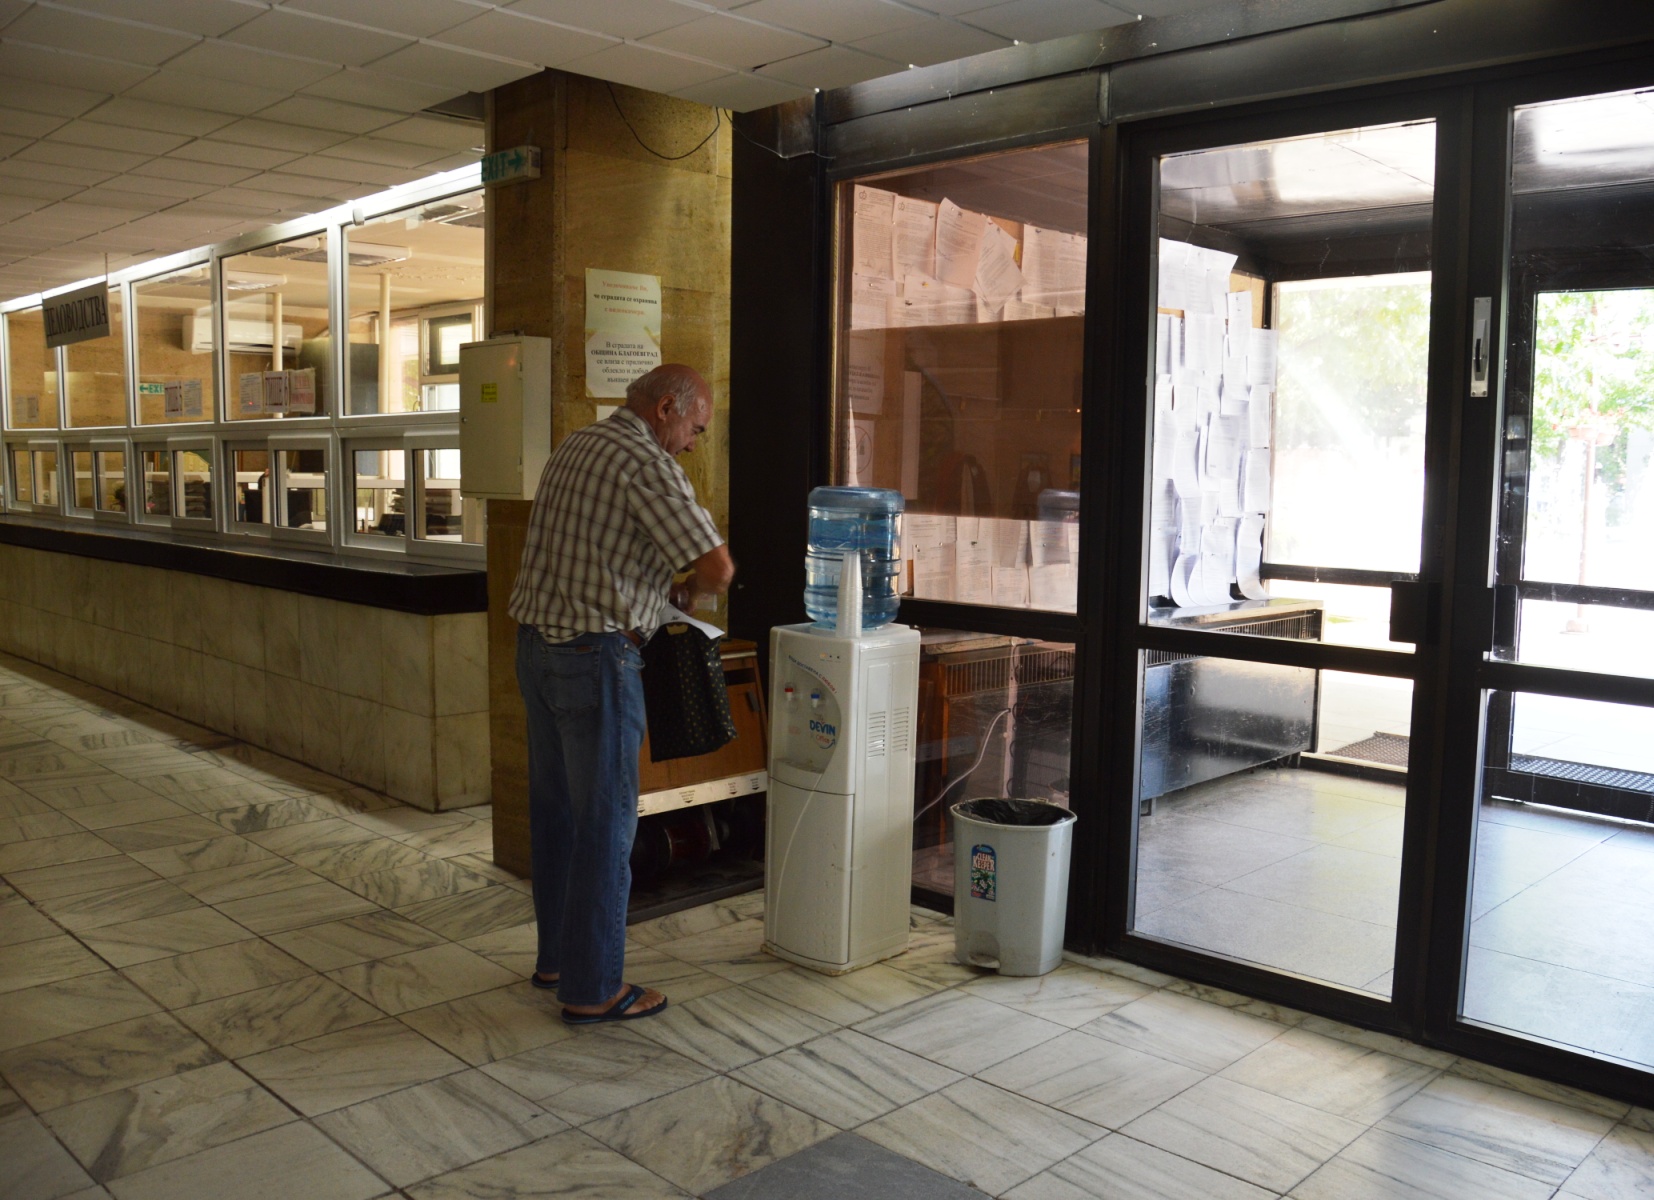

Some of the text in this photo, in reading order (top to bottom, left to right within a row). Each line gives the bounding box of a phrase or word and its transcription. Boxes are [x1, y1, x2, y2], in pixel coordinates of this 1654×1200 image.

[481, 152, 508, 182] EXIT
[44, 295, 108, 338] ДЕЛОВОДСТВА
[809, 720, 836, 736] DEVIN
[972, 856, 995, 871] KEEPER
